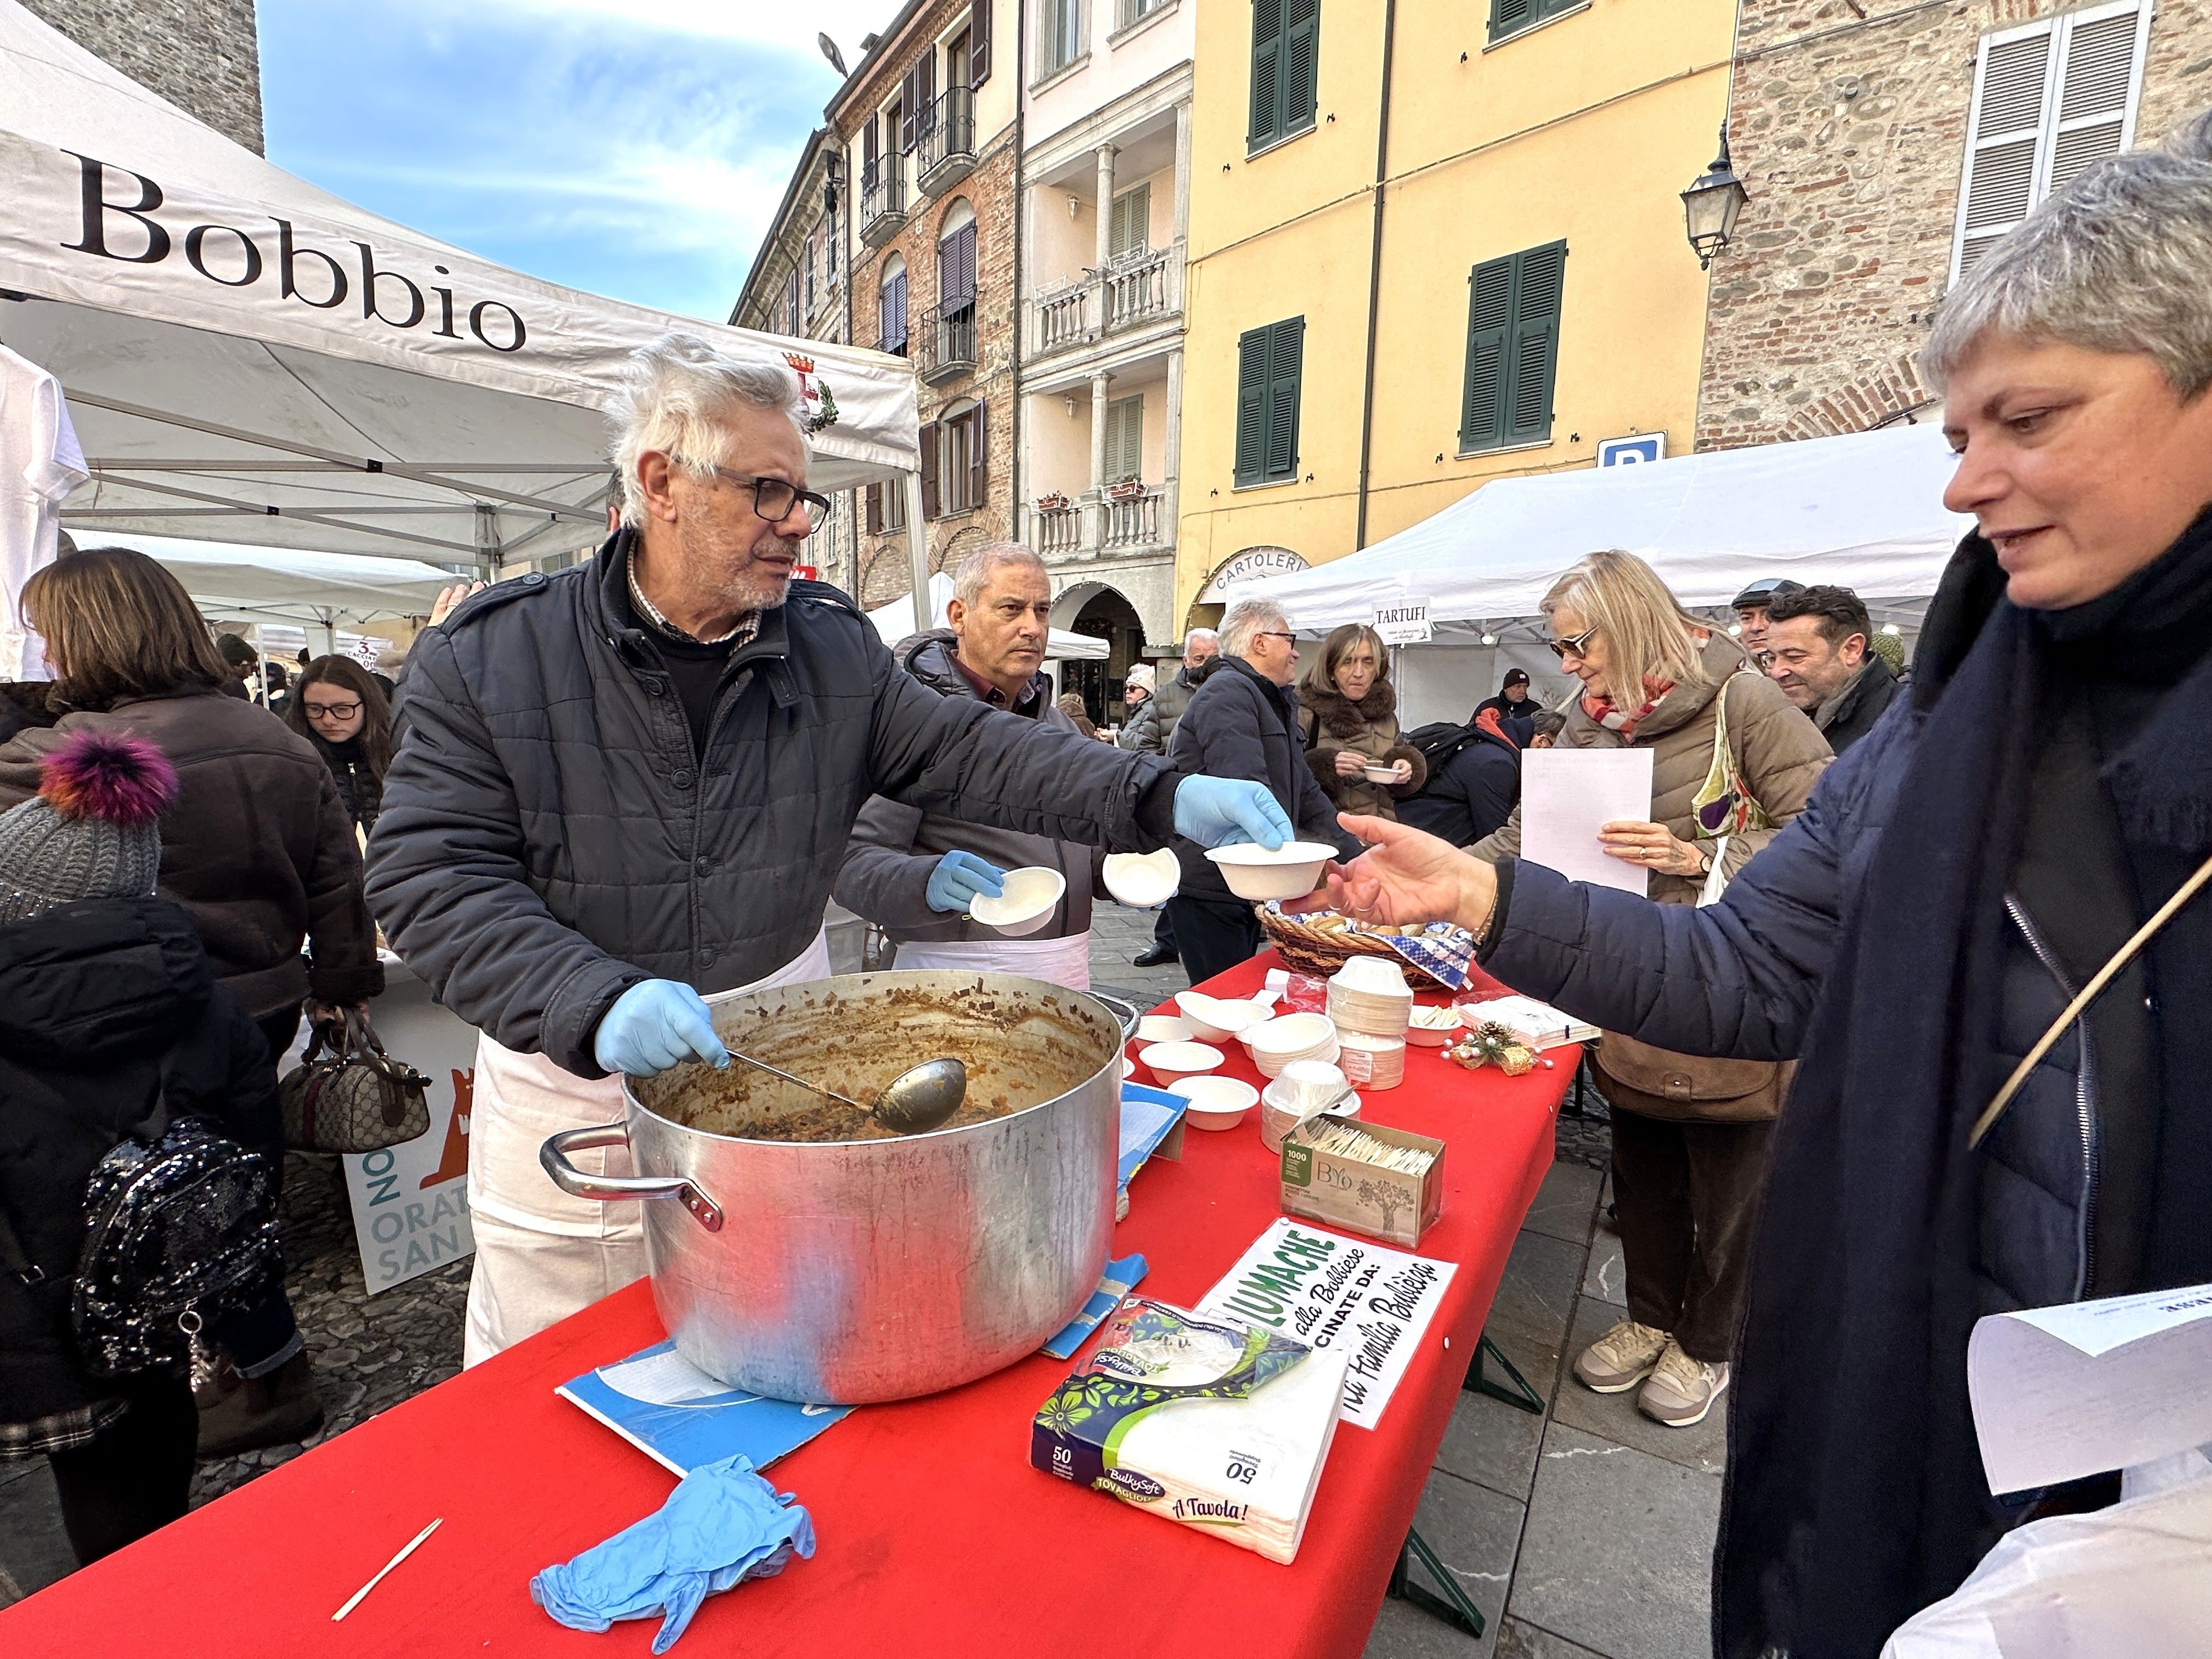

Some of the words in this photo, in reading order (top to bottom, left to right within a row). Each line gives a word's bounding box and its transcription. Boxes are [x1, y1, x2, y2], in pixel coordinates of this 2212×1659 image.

[60, 148, 526, 352] Bobbio
[1376, 606, 1426, 624] TARTUFI
[1287, 1150, 1307, 1162] 1000
[377, 1225, 459, 1280] SAN
[1222, 1230, 1337, 1327] LUMACHE
[1355, 1264, 1380, 1288] DA:
[1294, 1306, 1323, 1336] alla
[1310, 1248, 1364, 1305] Bobbiese
[1052, 1445, 1071, 1464] 50
[1109, 1468, 1160, 1494] BulkySoft
[1226, 1463, 1257, 1485] 50
[1172, 1499, 1185, 1519] A
[1187, 1498, 1248, 1521] Tavola!
